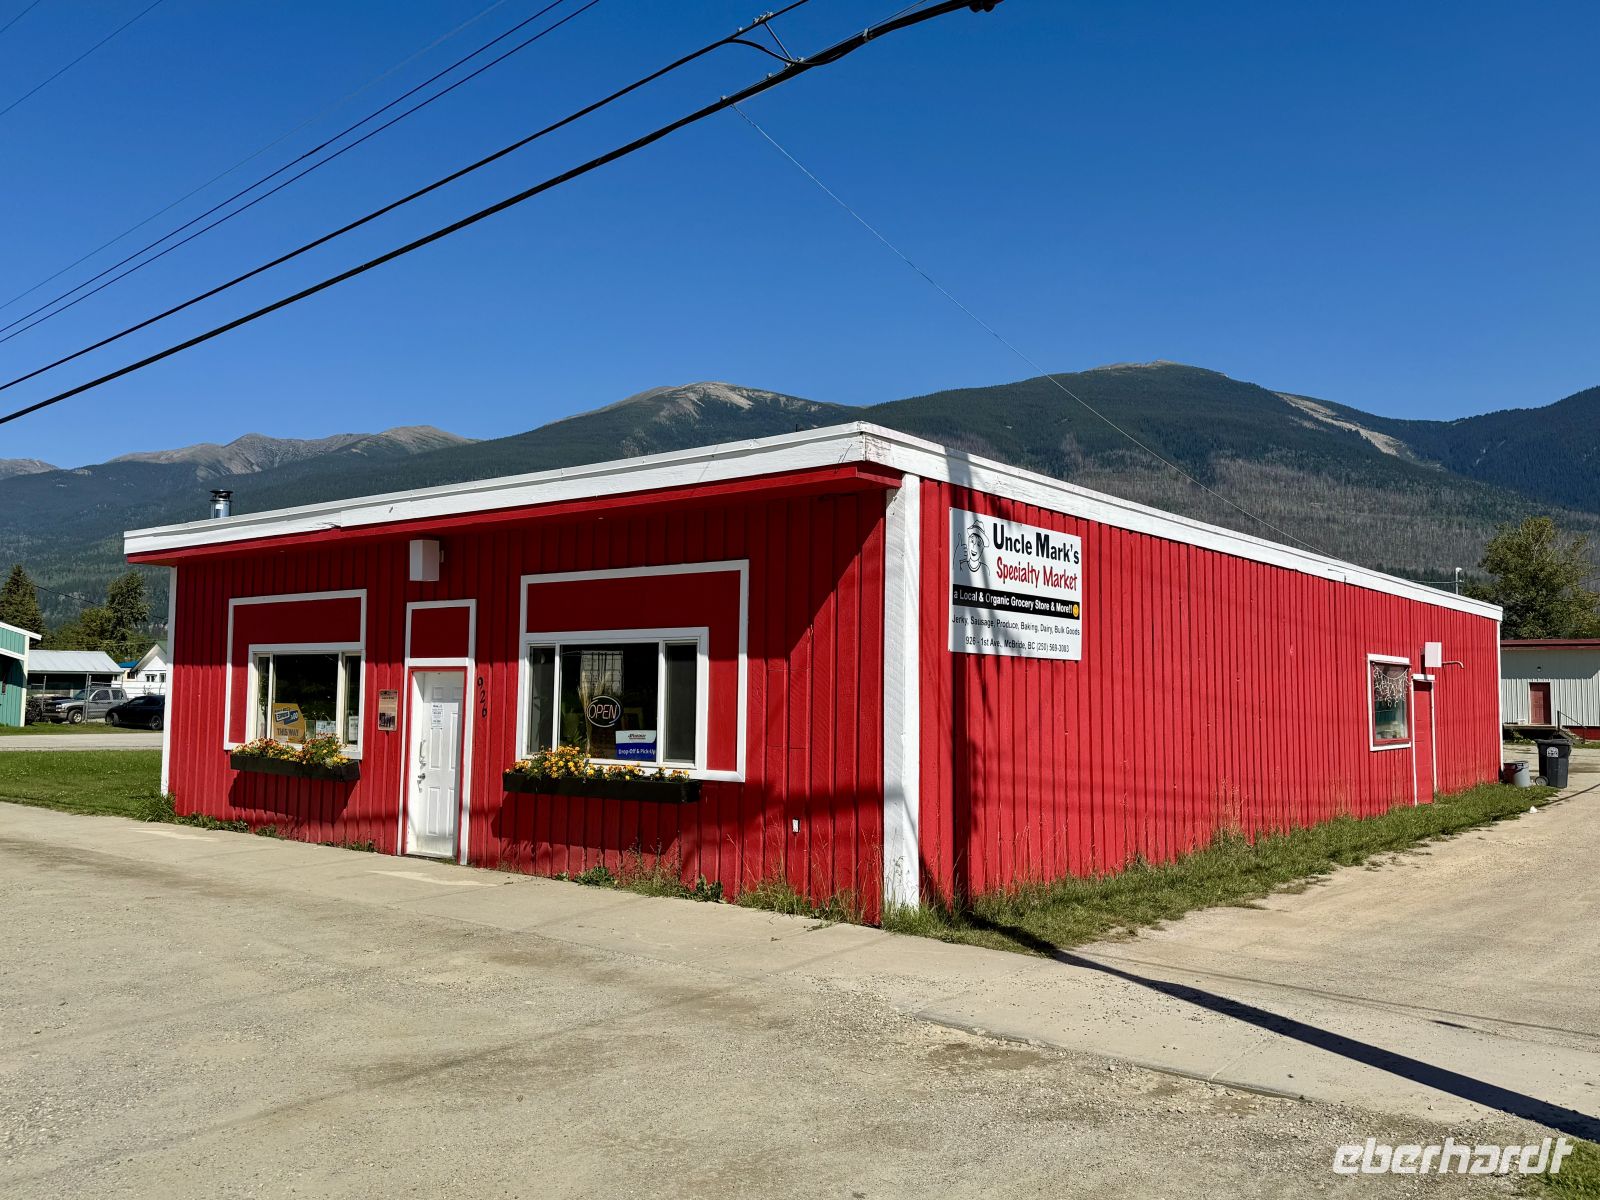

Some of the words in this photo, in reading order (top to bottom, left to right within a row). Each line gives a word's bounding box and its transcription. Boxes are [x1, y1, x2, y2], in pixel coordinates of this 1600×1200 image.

[993, 523, 1032, 555] Uncle
[1036, 532, 1080, 564] Mark's
[996, 556, 1040, 588] Specialty
[1043, 565, 1077, 592] Market
[953, 591, 959, 599] a
[959, 589, 978, 601] Local
[978, 592, 984, 602] &
[985, 594, 1010, 606] Organic
[1011, 596, 1034, 611] Grocery
[1035, 599, 1050, 611] Store
[1050, 602, 1055, 611] &
[970, 616, 995, 628] Sausage,
[996, 619, 1020, 631] Produce,
[1054, 625, 1065, 634] Bulk
[1065, 626, 1080, 636] Goods
[980, 637, 989, 646] 1st
[1027, 641, 1036, 650] BC
[589, 704, 617, 719] OPEN
